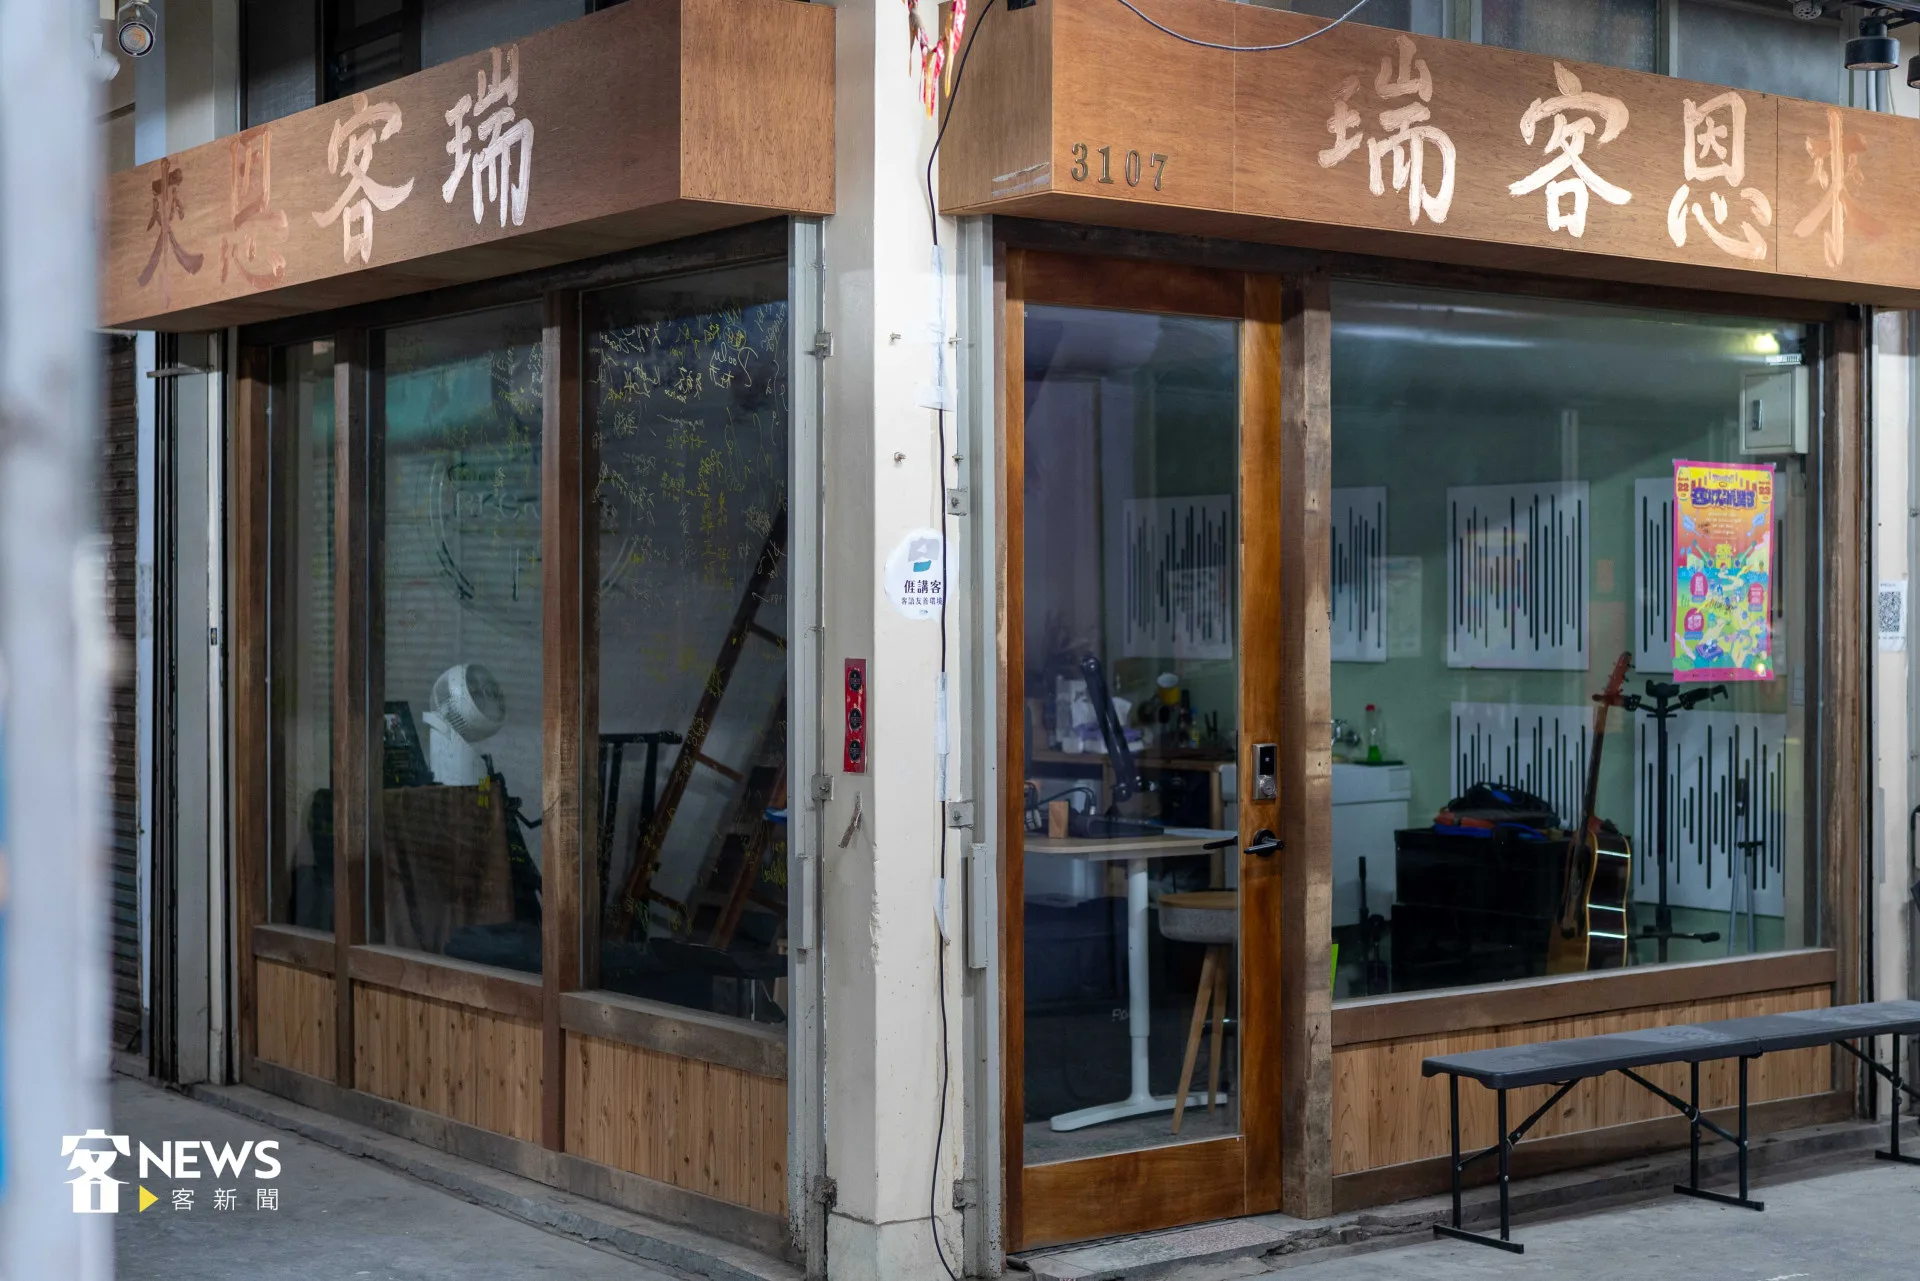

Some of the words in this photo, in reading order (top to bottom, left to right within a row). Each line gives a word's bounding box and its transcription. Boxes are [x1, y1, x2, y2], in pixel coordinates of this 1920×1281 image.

[1070, 142, 1169, 191] 3107
[1677, 483, 1689, 492] 22
[1758, 486, 1771, 495] 23
